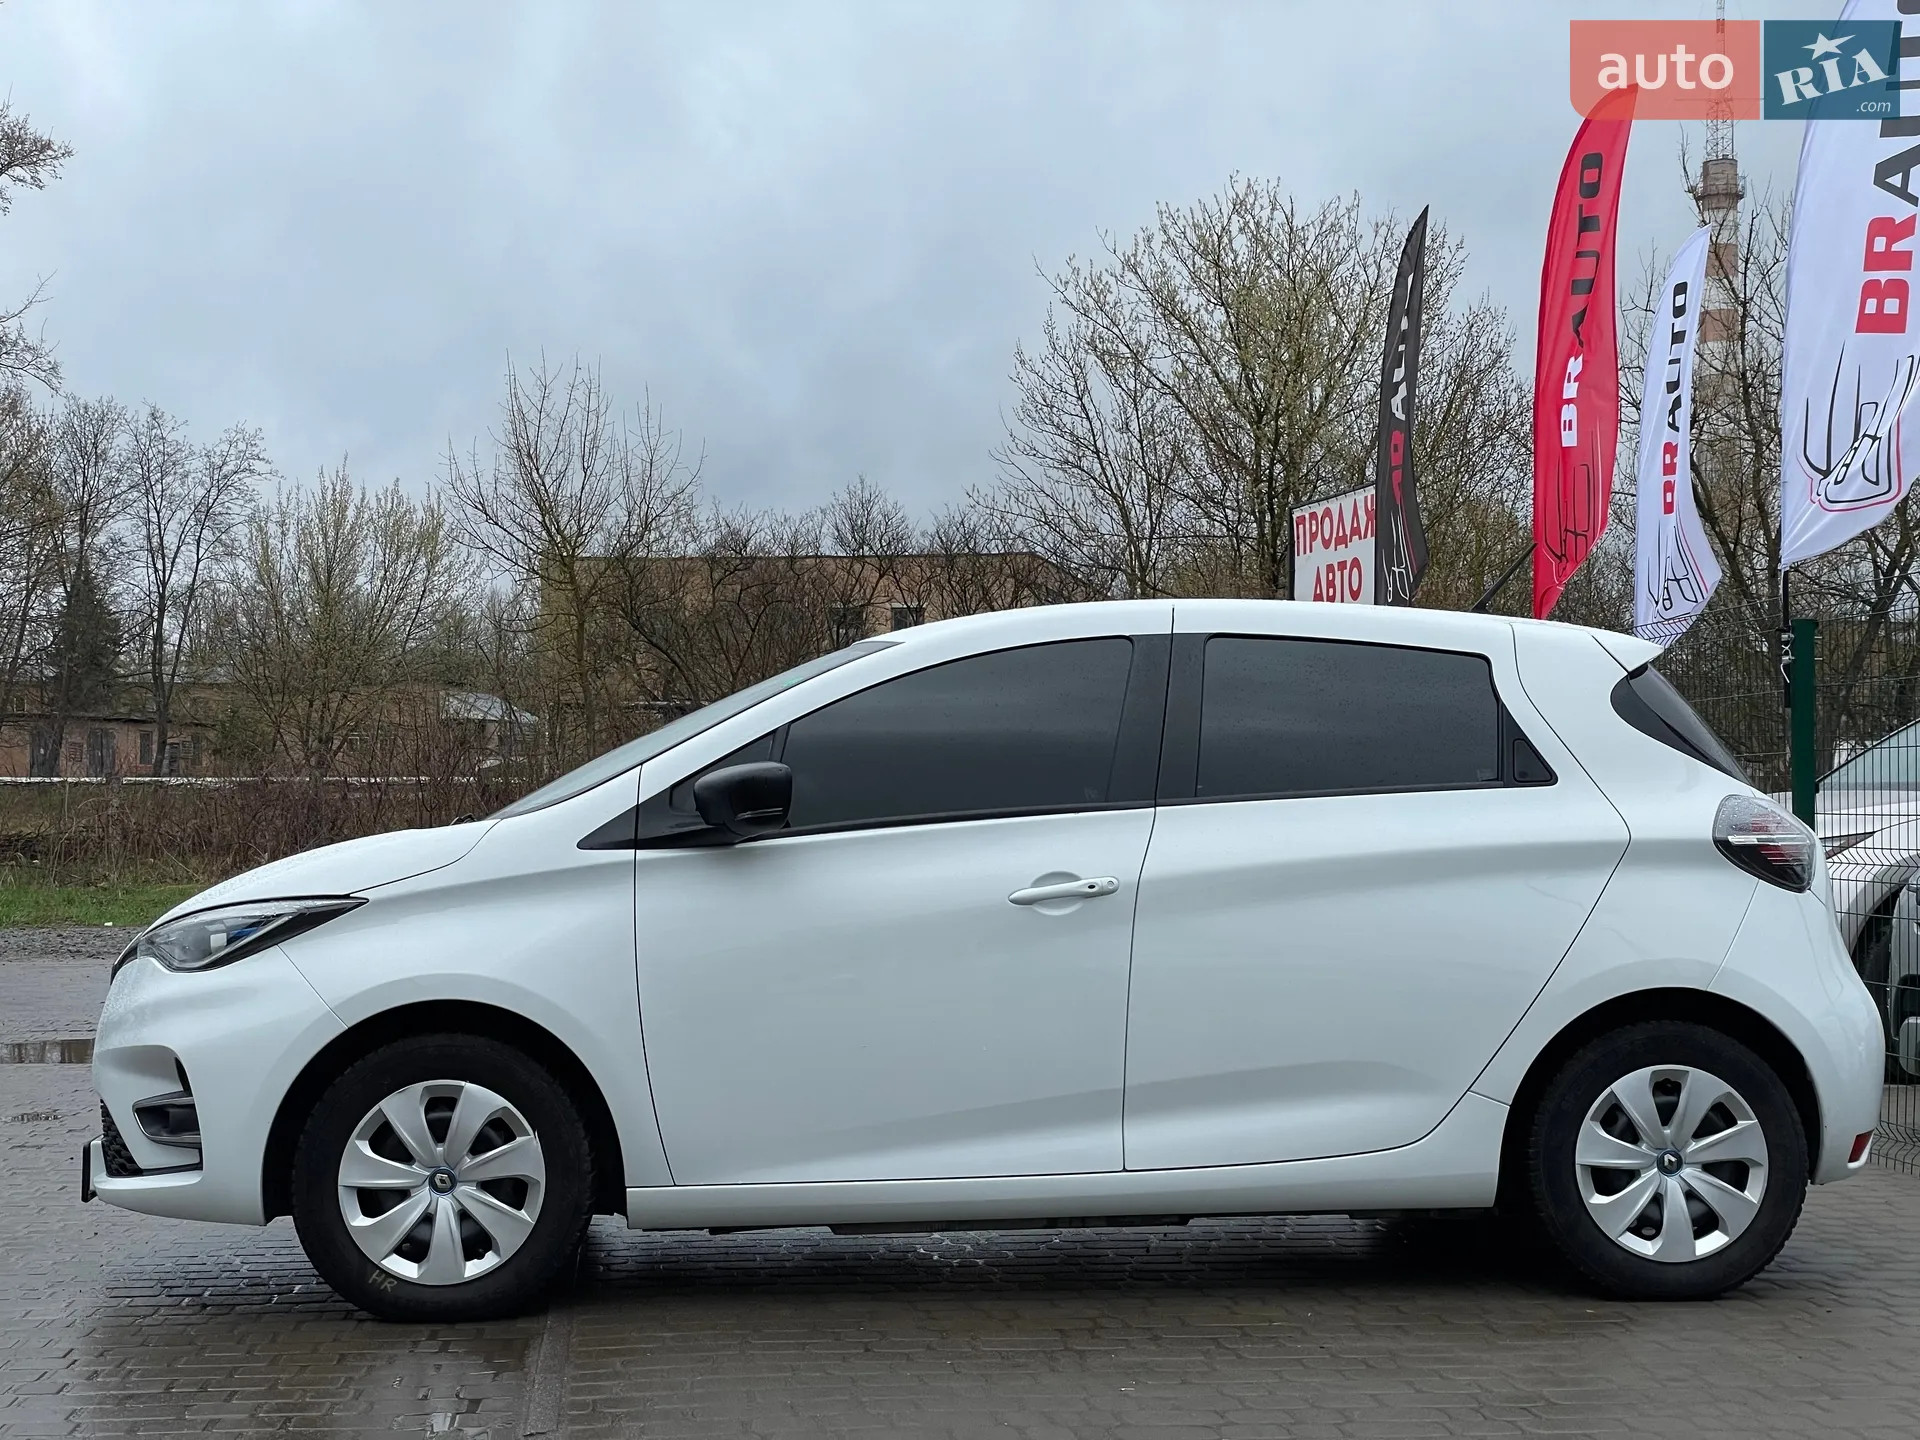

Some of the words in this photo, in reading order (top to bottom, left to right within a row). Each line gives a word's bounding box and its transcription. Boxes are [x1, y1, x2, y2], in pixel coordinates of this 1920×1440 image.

[1560, 151, 1603, 448] BRAUTO
[1313, 556, 1363, 602] АВТО
[368, 1269, 398, 1293] HR
